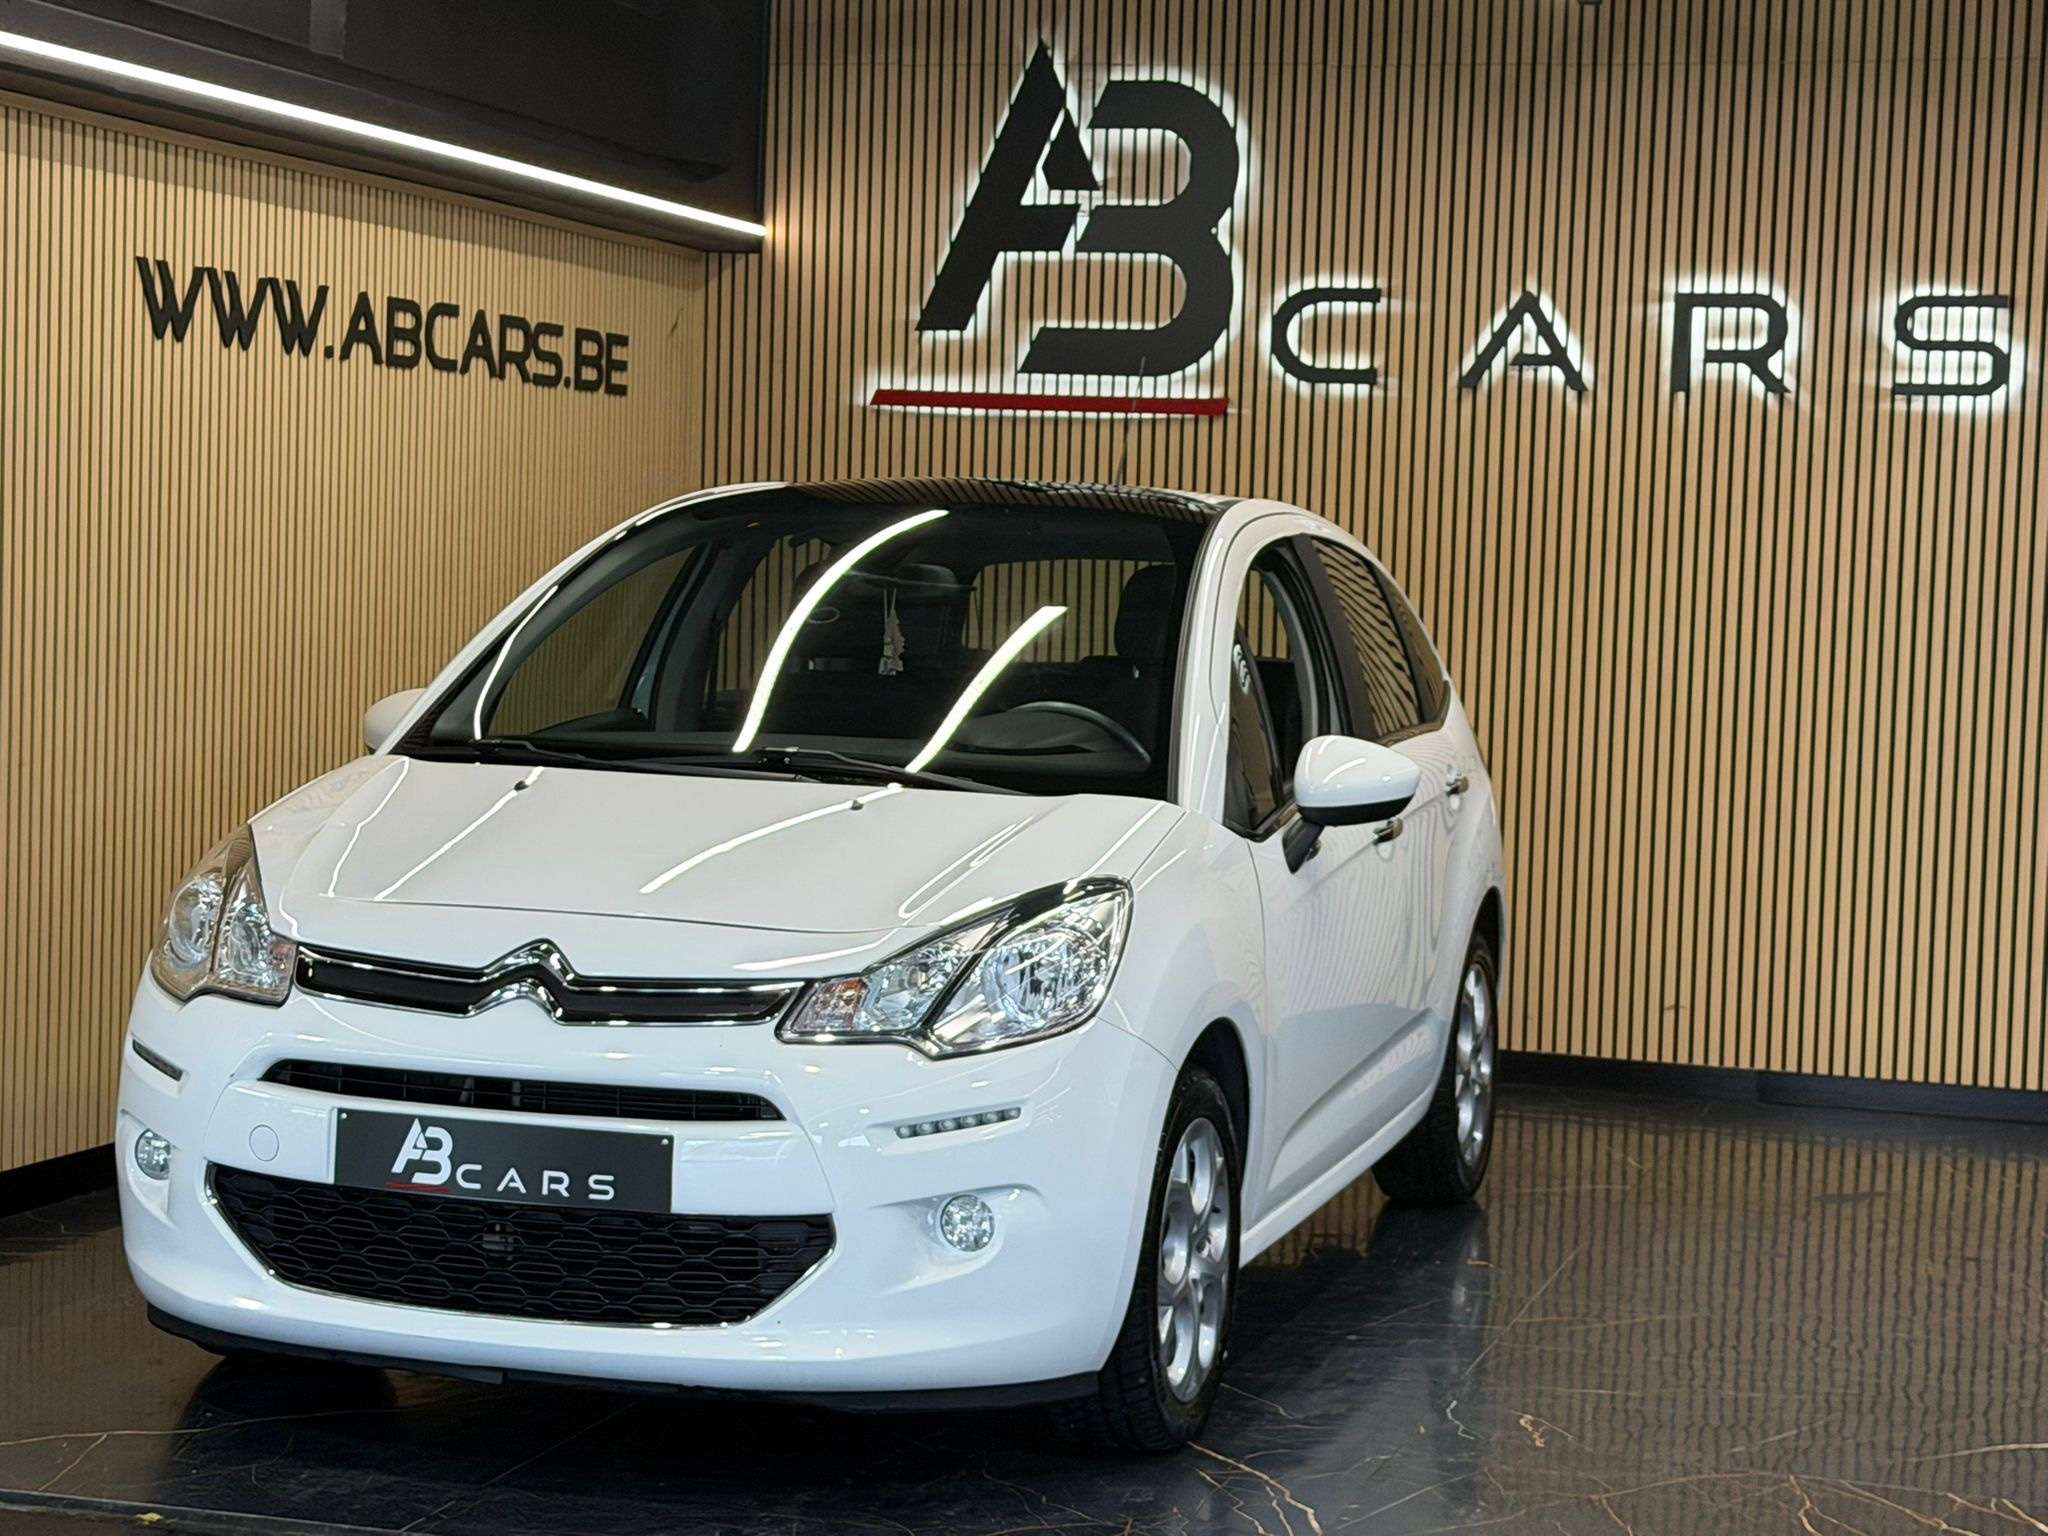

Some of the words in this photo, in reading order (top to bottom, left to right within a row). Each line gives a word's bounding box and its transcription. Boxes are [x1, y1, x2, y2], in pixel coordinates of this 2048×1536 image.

[914, 38, 1240, 378] AB
[1272, 287, 2012, 398] CARS
[135, 256, 630, 396] WWW.ABCARS.BE
[390, 1117, 454, 1185] AB
[455, 1163, 615, 1201] CARS
